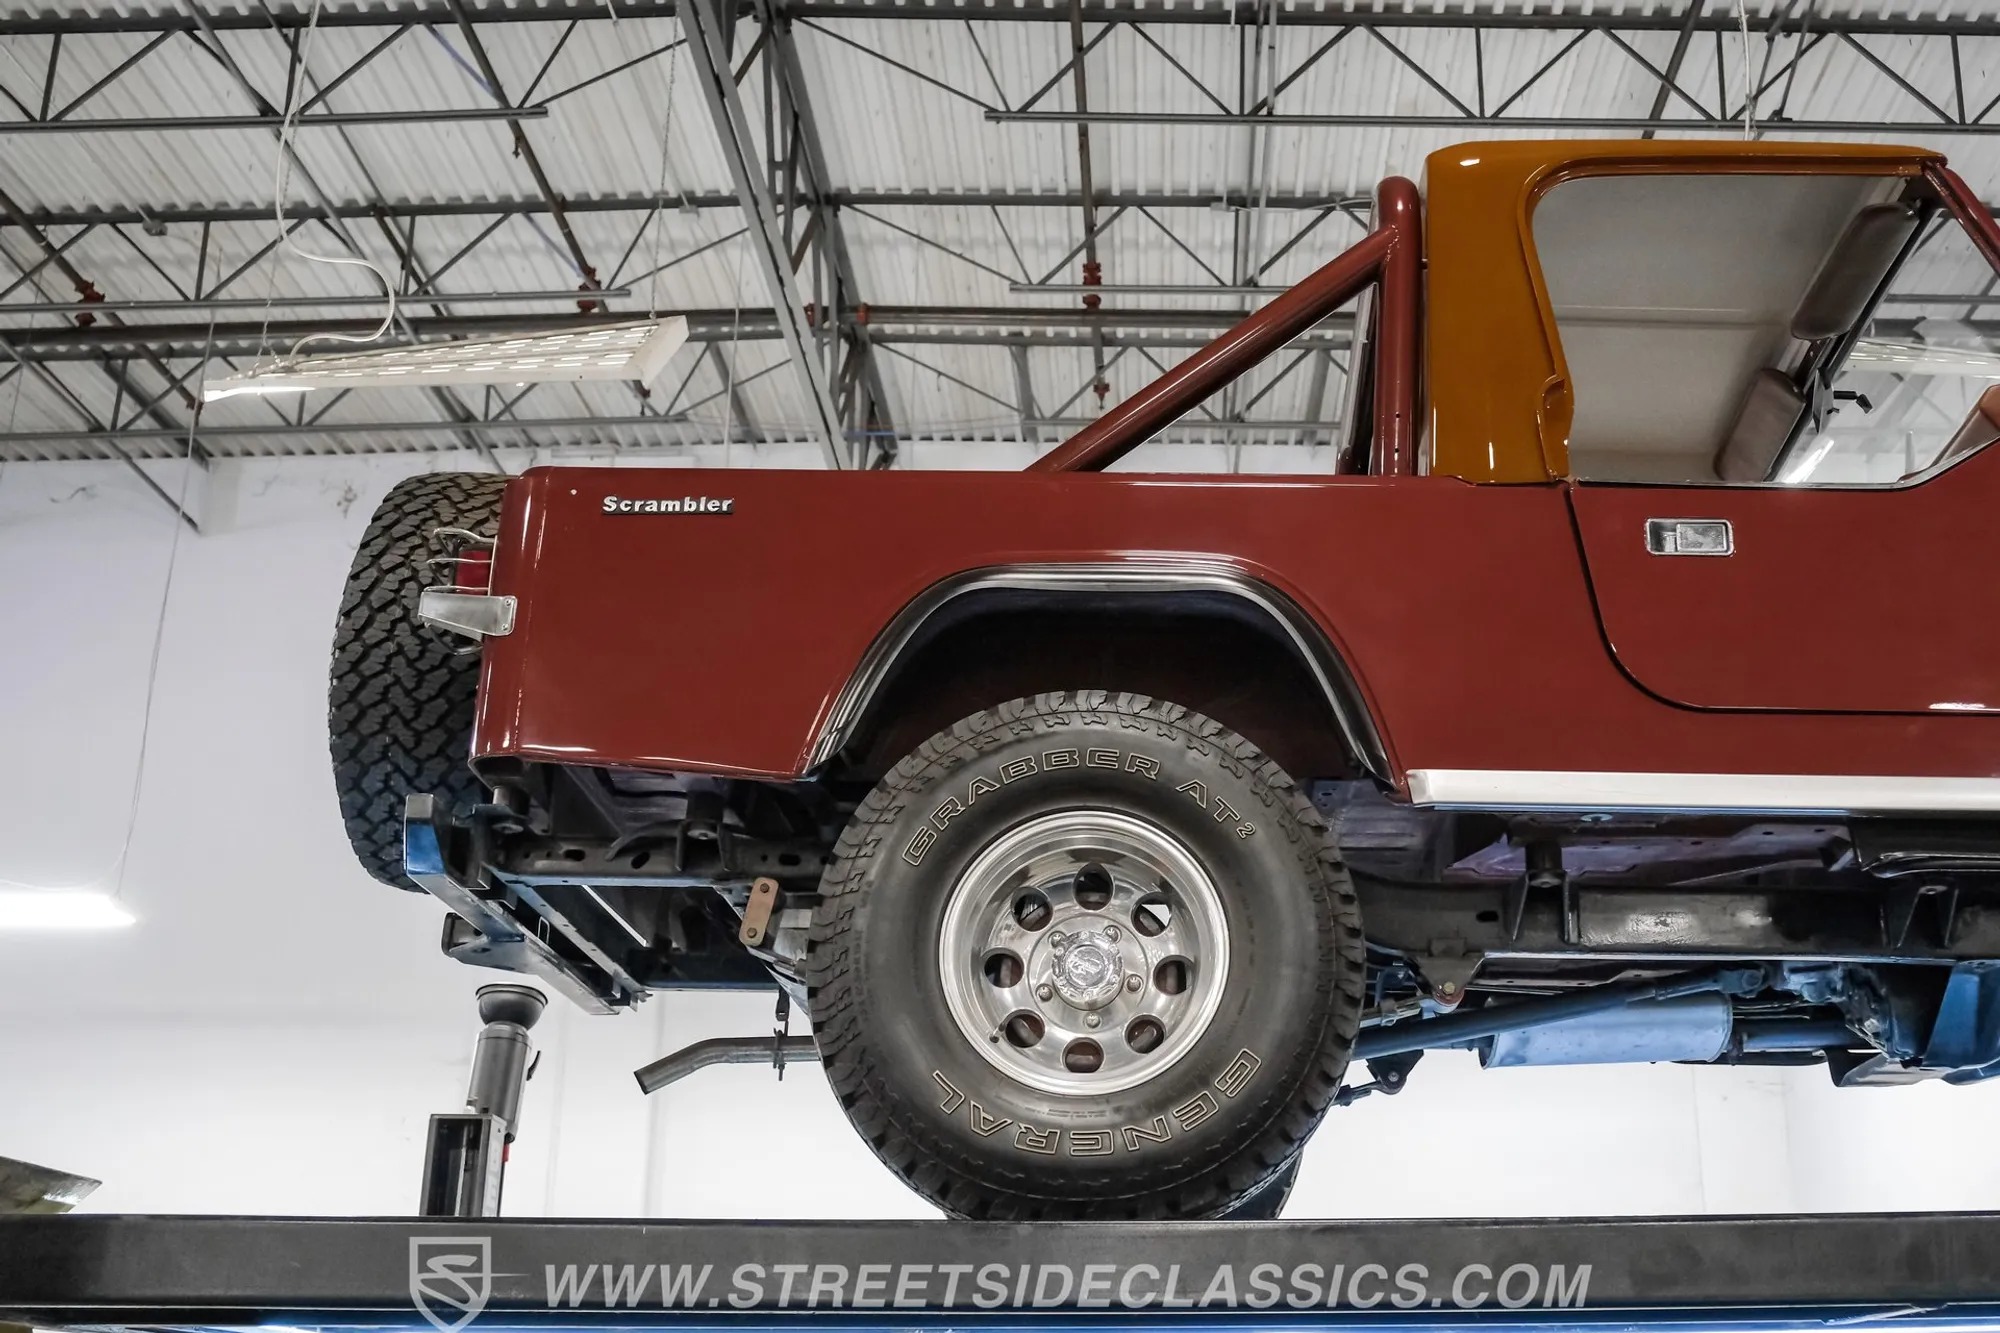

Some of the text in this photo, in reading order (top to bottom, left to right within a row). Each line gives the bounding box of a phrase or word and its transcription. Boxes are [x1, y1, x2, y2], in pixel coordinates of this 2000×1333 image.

[602, 495, 734, 513] Scrambler
[902, 747, 1161, 866] GRABBER
[932, 1048, 1262, 1157] GENERAL
